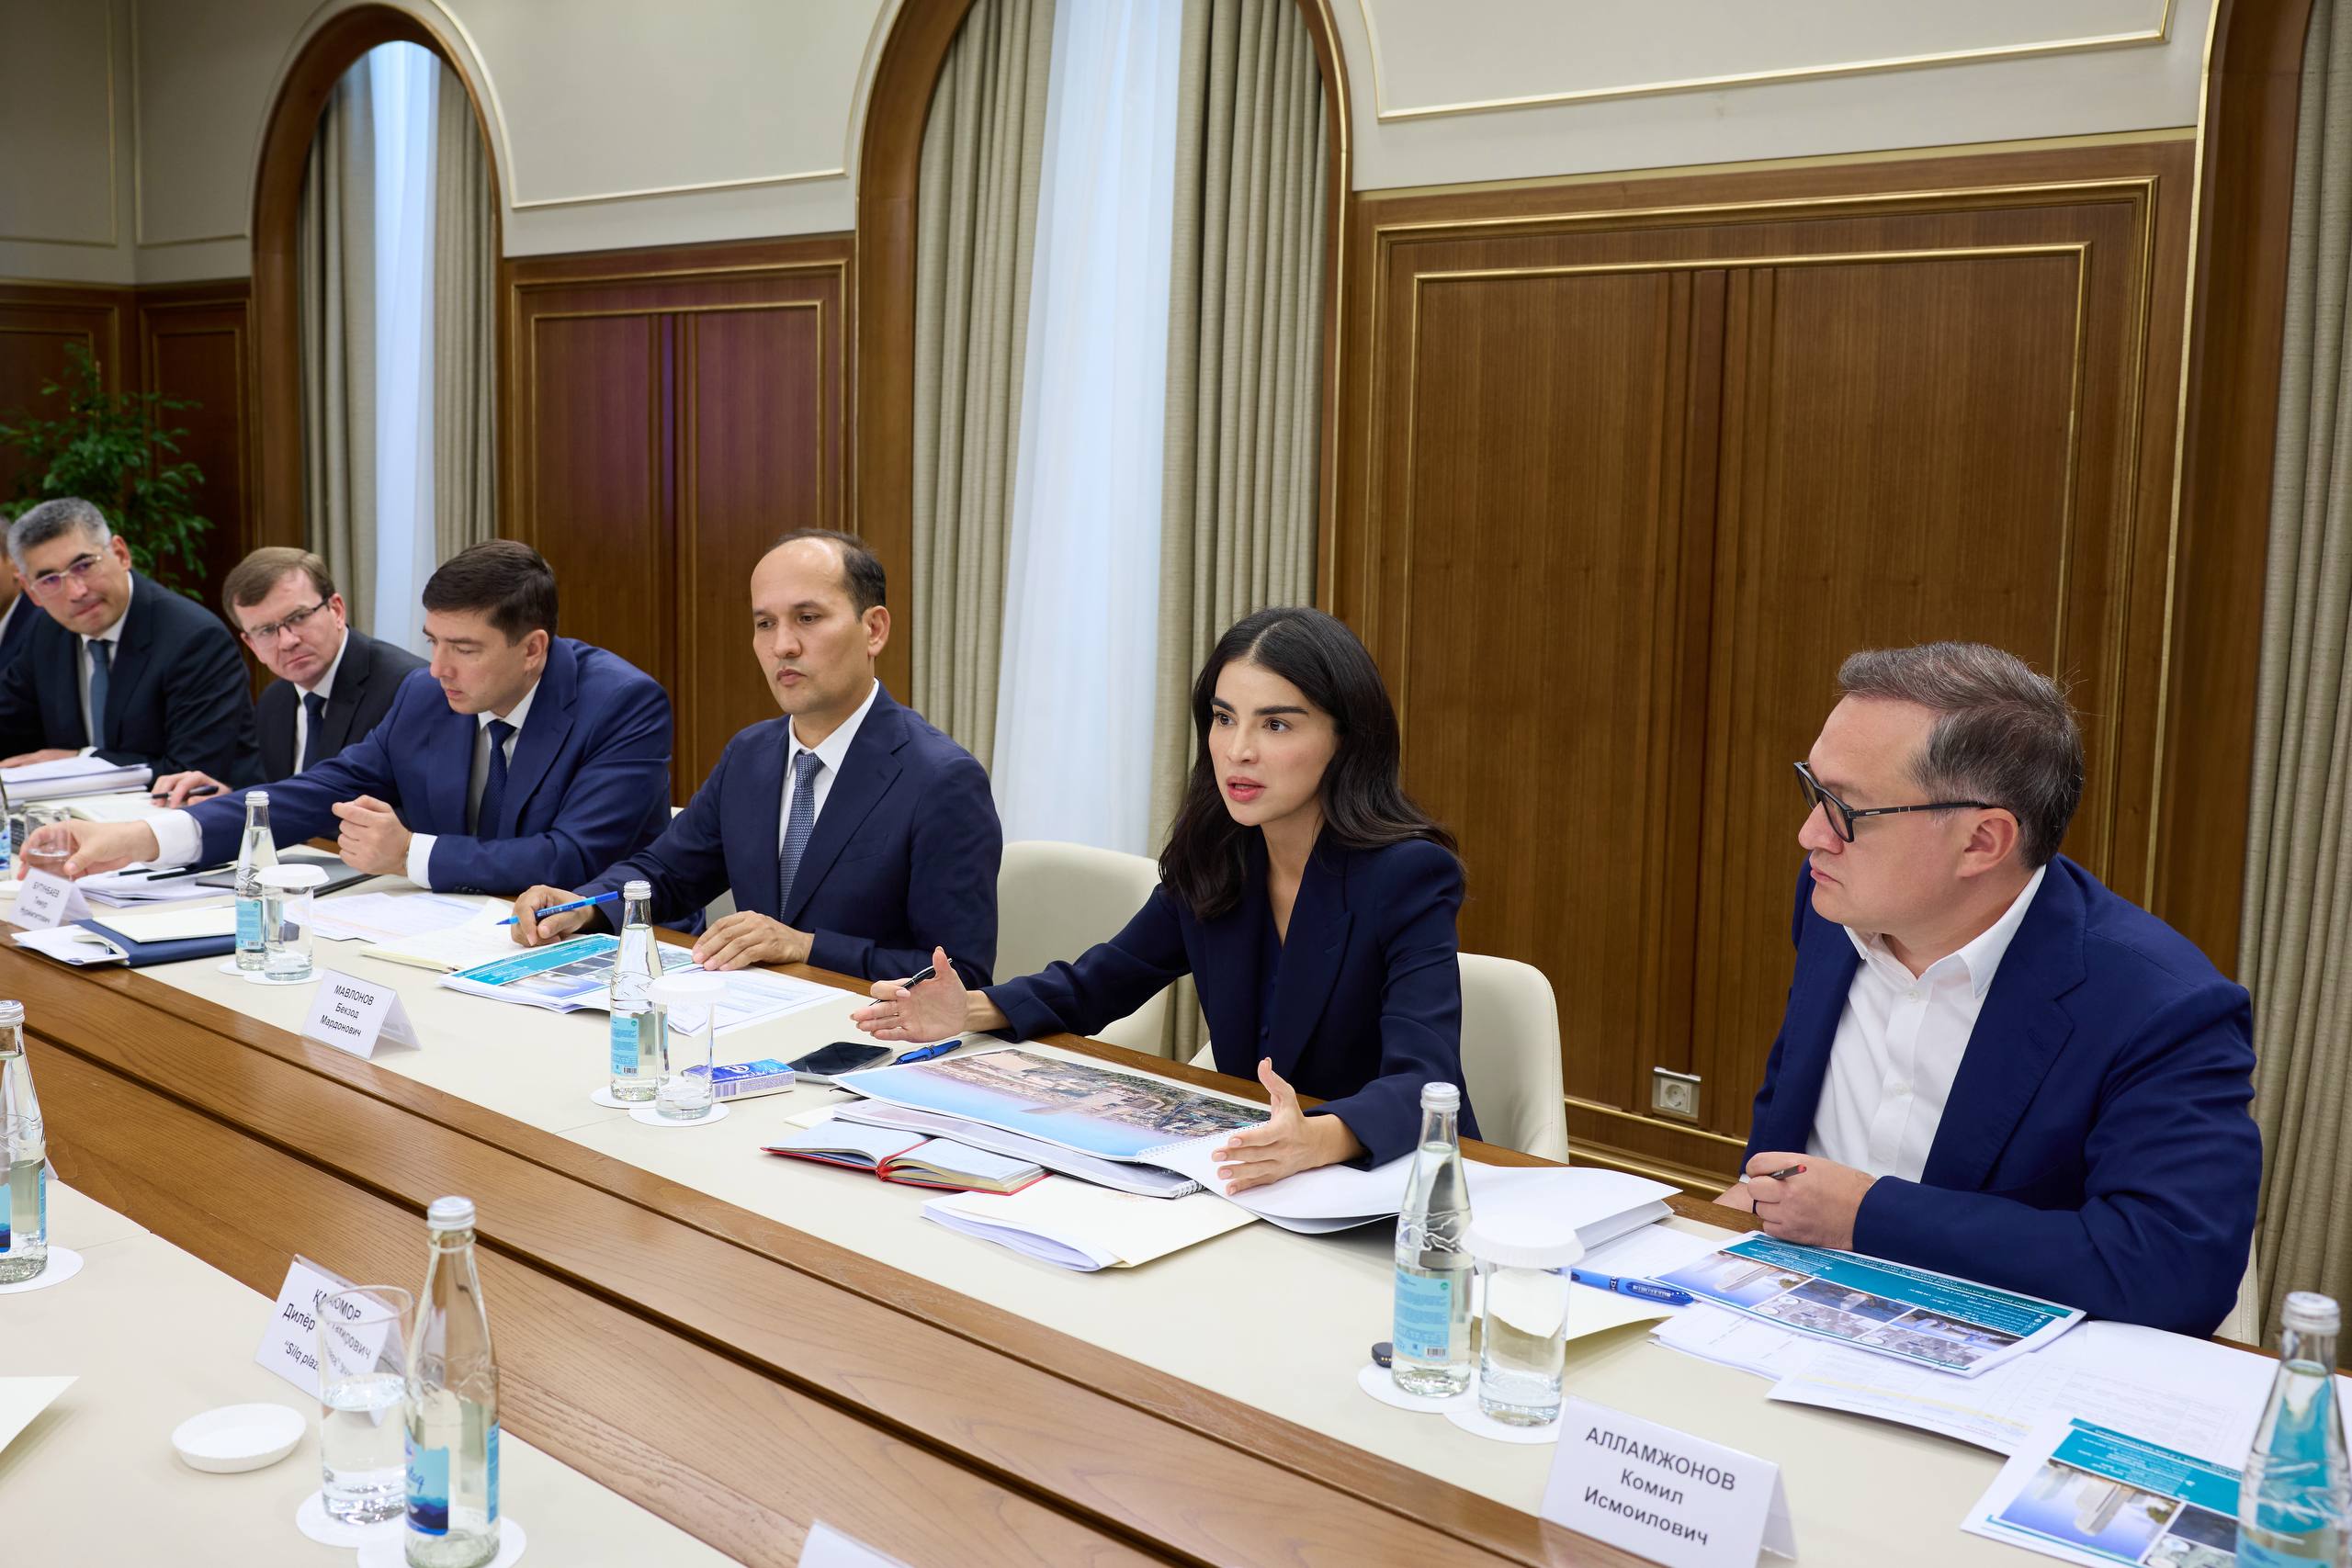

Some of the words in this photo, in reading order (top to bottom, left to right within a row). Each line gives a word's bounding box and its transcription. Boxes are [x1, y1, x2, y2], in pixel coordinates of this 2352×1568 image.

[334, 985, 375, 1006] МАВЛОНОВ
[335, 1002, 359, 1019] Бекзод
[320, 1014, 361, 1037] Мардонович
[282, 1303, 316, 1332] Дилёр
[301, 1356, 321, 1372] plaz
[1586, 1427, 1736, 1491] АЛЛАМЖОНОВ
[1621, 1468, 1684, 1505] Комил
[1584, 1486, 1709, 1546] Исмоилович
